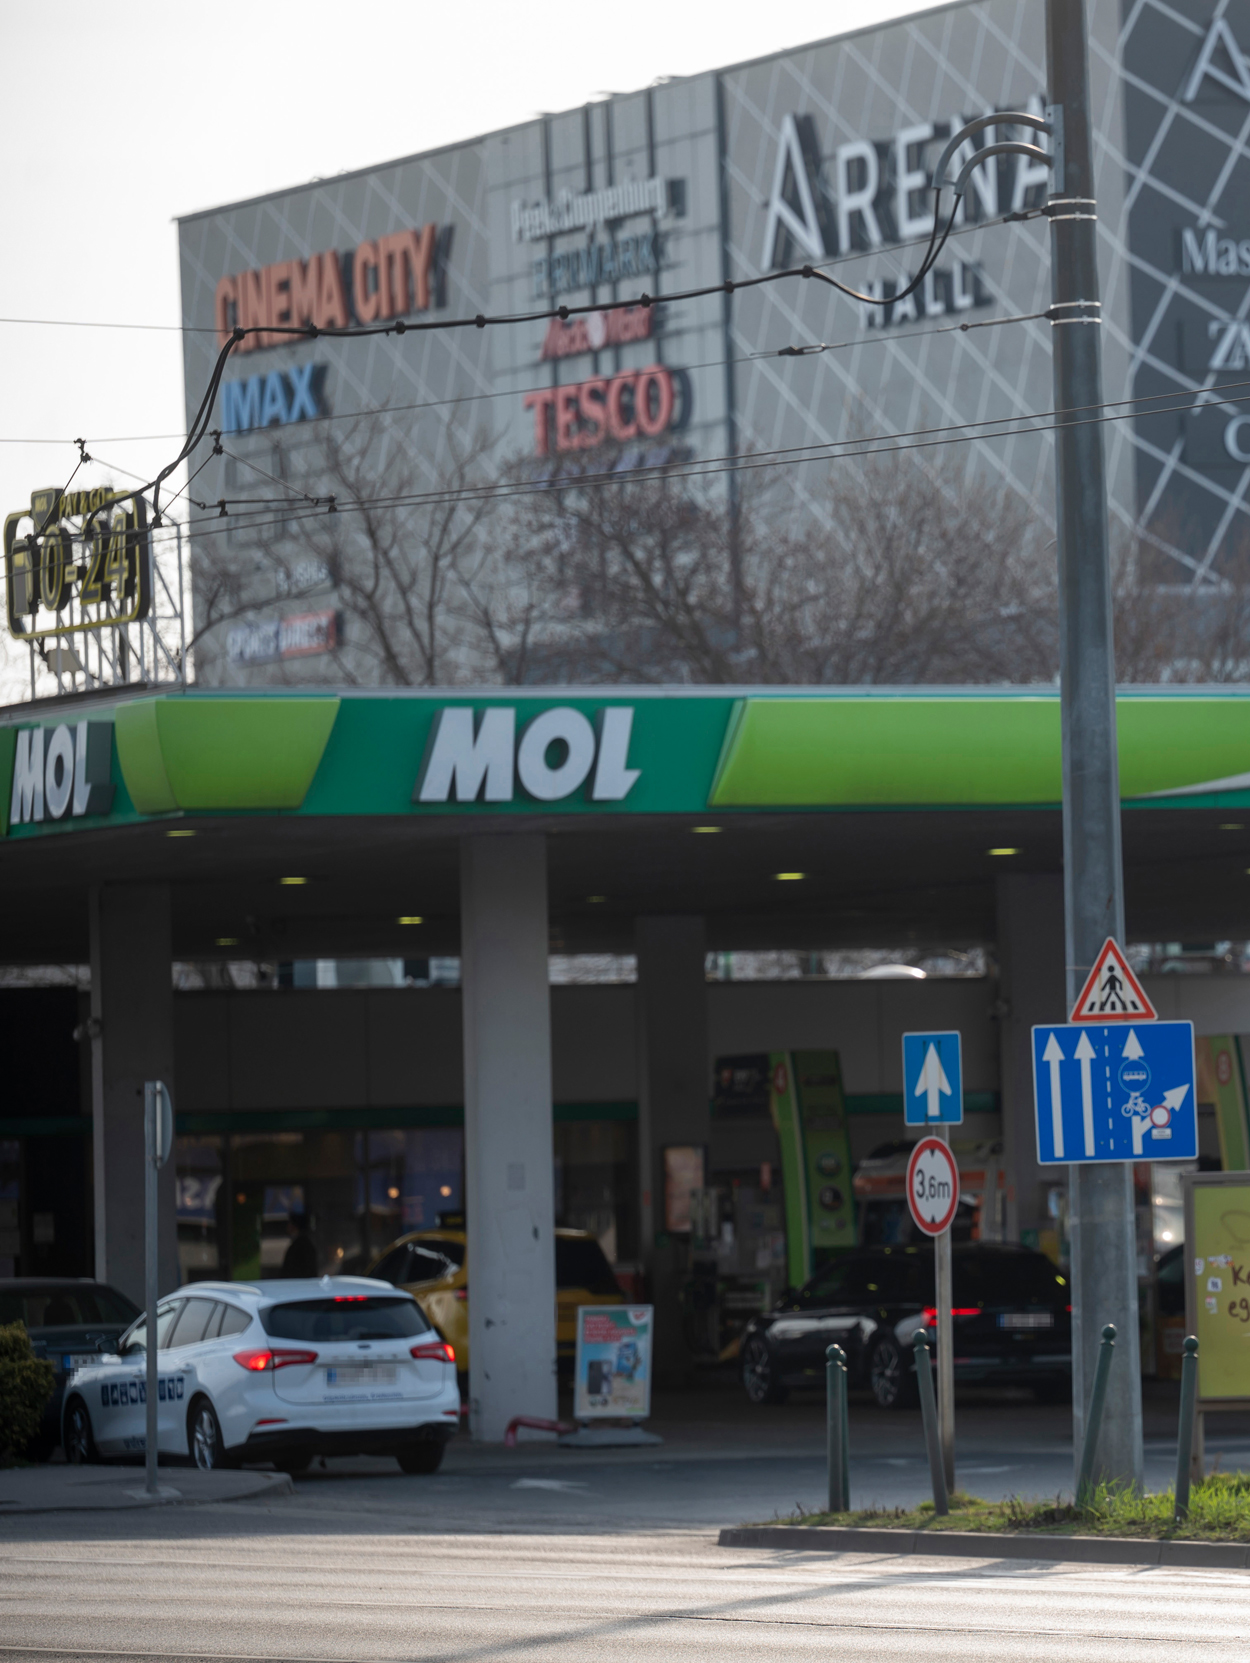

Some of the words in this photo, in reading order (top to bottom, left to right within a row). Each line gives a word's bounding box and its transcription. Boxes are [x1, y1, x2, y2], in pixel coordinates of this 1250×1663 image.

[762, 95, 1048, 271] ARENA
[215, 249, 351, 355] CINEMA
[354, 222, 436, 326] CITY
[220, 361, 319, 438] IMAX
[523, 364, 674, 457] TESCO
[10, 719, 92, 826] MOL
[418, 706, 642, 802] MOL
[916, 1168, 950, 1203] 3,6m
